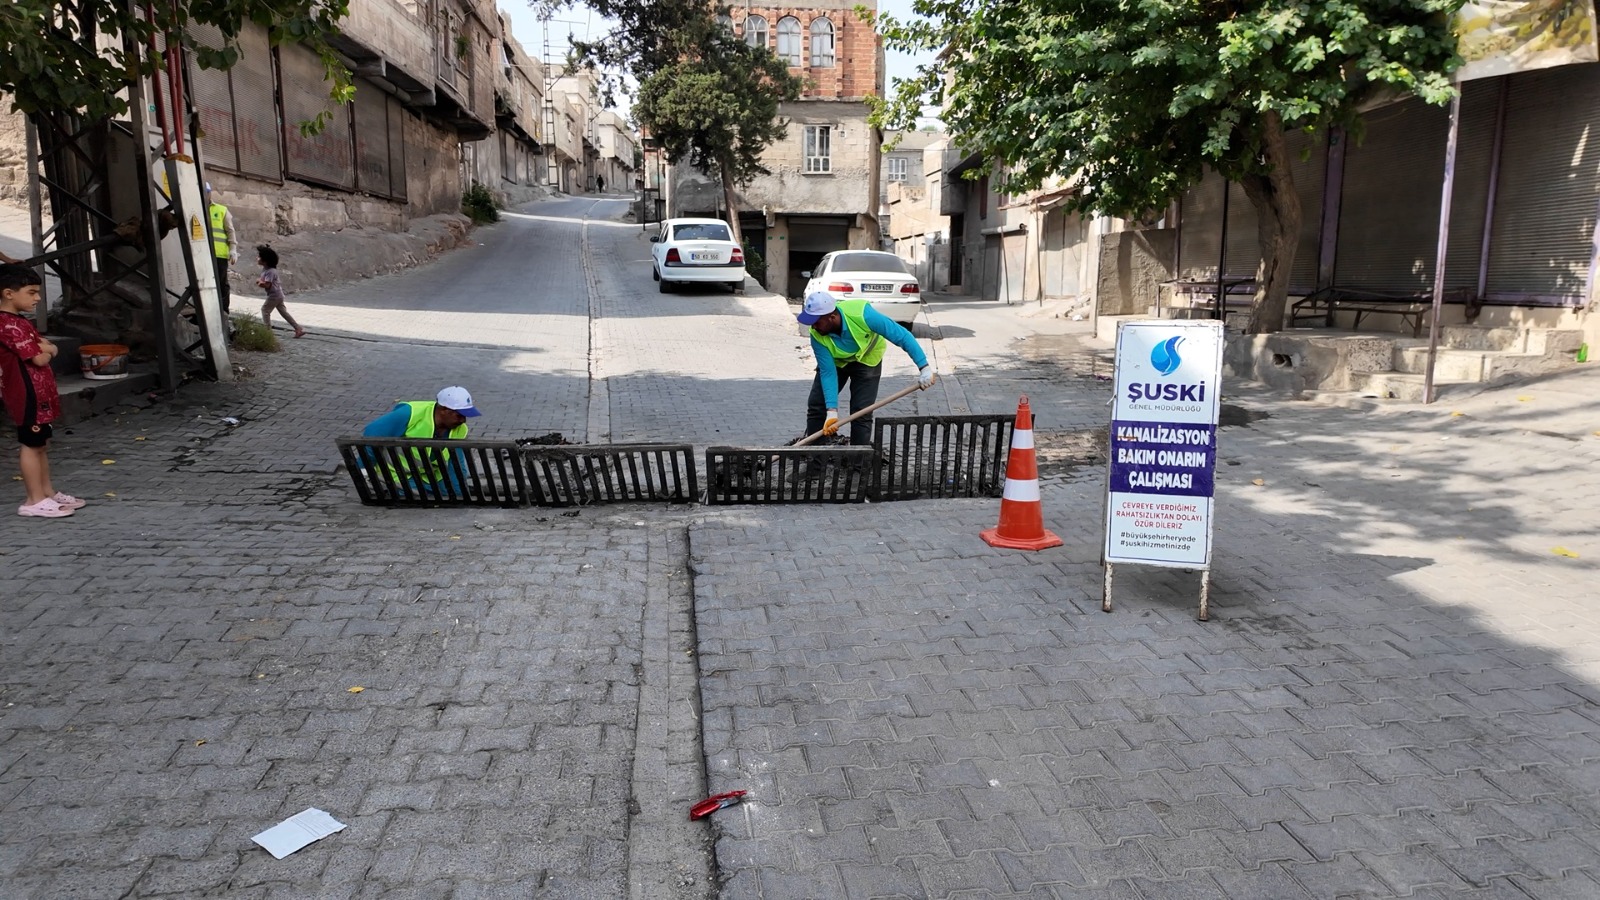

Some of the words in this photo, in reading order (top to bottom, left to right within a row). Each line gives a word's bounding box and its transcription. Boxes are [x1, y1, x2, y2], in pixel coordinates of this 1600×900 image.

[1128, 381, 1205, 403] ŞUSKİ
[1154, 403, 1202, 412] MÜDÜRLÜĞÜ
[1117, 425, 1210, 445] KANALİZASYON
[1117, 448, 1156, 465] BAKIM
[1157, 450, 1206, 468] ONARIM
[1129, 471, 1192, 490] ÇALIŞMASI
[1122, 502, 1154, 510] ÇEVREYE
[1116, 511, 1174, 520] RAHATSIZLIKTAN
[1176, 514, 1202, 522] DOLAYI
[1134, 520, 1154, 528] ÖZÜR
[1121, 532, 1196, 542] #büyükşehirheryede
[1121, 540, 1191, 551] #şuskihizmetinizde
